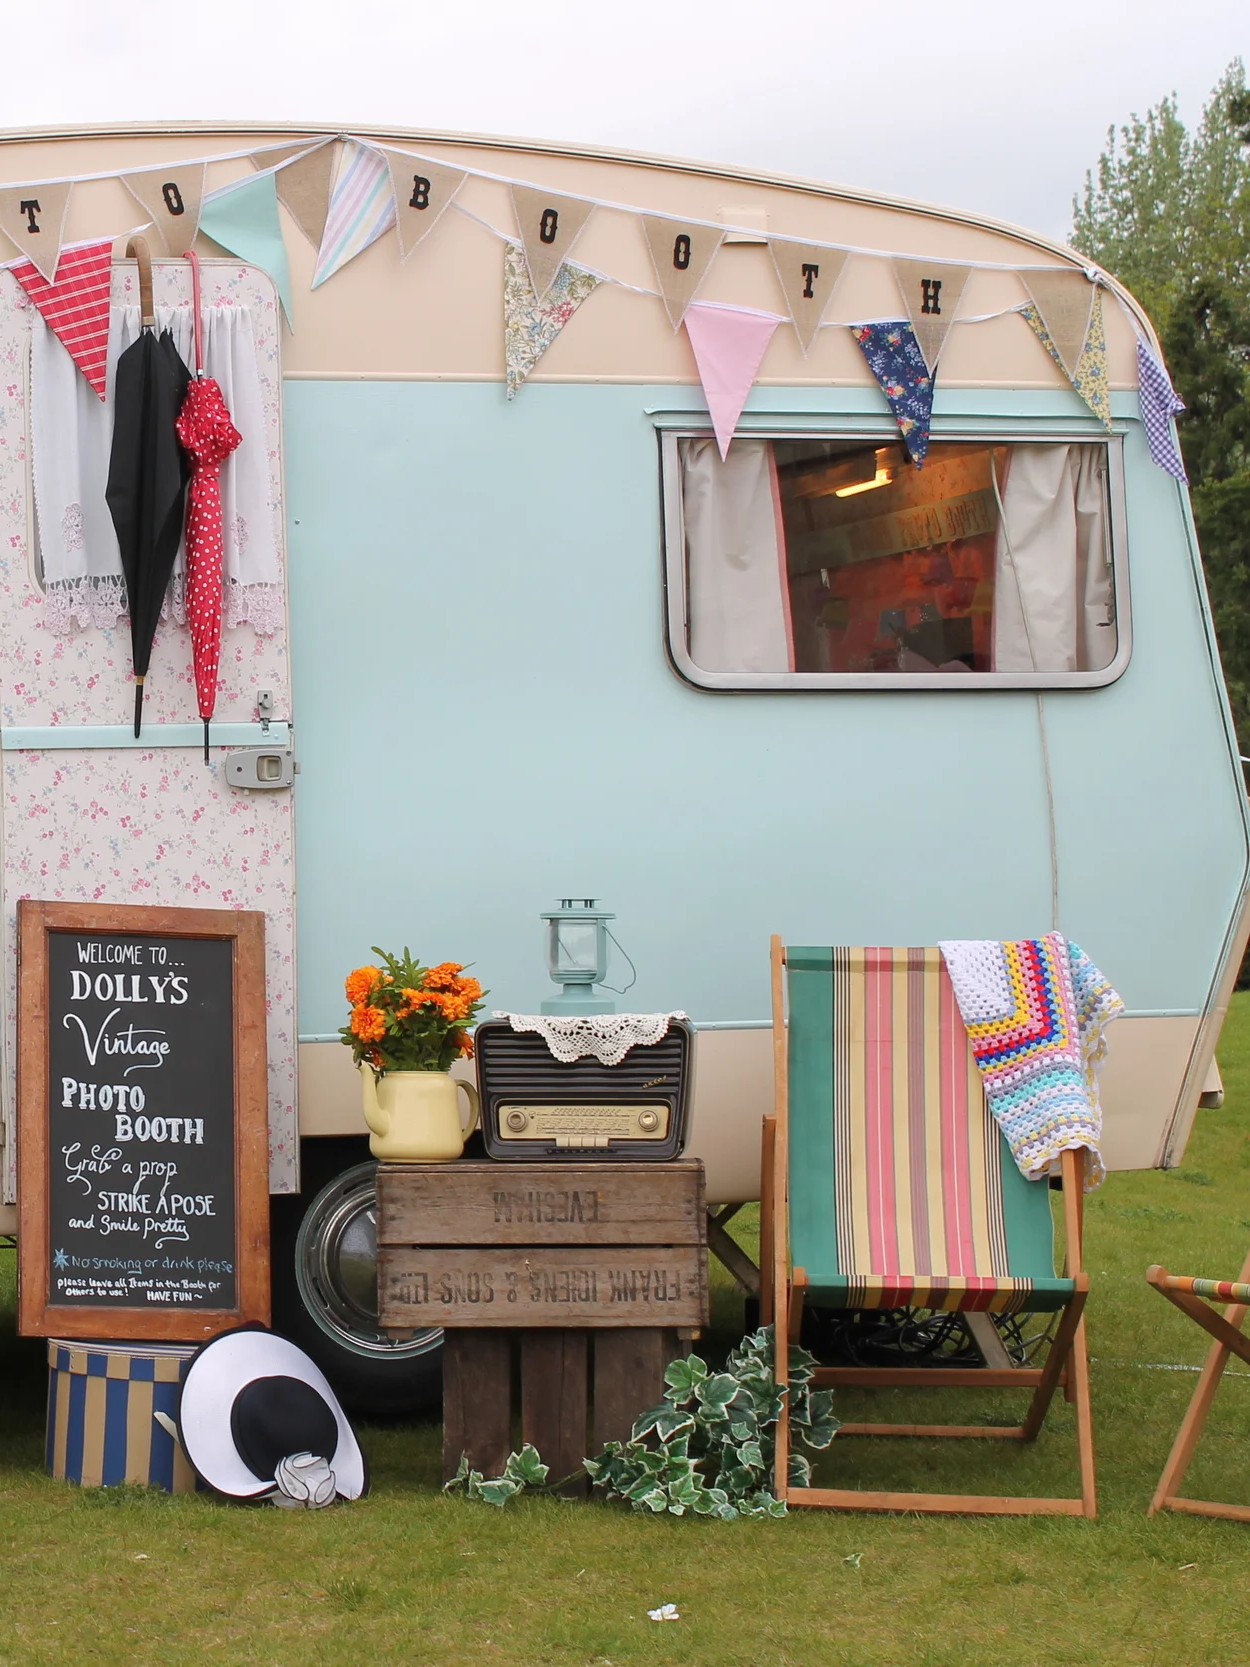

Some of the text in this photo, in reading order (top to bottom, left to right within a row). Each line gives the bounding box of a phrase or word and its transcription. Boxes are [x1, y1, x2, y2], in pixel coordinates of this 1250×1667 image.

[408, 174, 941, 315] BOOTH
[77, 941, 143, 965] WELCOME
[70, 970, 189, 1005] DOLLY'S
[62, 1007, 170, 1077] Vintage
[61, 1076, 145, 1112] PHOTO
[114, 1114, 205, 1145] BOOTH
[61, 1142, 178, 1196] Grab a prop
[97, 1191, 216, 1216] STRIKE A POSE
[68, 1214, 95, 1229] and
[100, 1214, 140, 1235] Smile
[72, 1256, 90, 1268] No
[144, 1259, 158, 1268] or
[162, 1256, 194, 1269] drink
[197, 1257, 233, 1273] please
[57, 1277, 86, 1290] please
[88, 1277, 113, 1287] leave
[114, 1278, 127, 1288] all
[155, 1278, 164, 1288] in
[165, 1279, 180, 1288] the
[181, 1279, 207, 1290] Booth
[208, 1281, 221, 1293] for
[65, 1287, 95, 1296] Others
[97, 1287, 107, 1296] to
[146, 1290, 193, 1302] HAVE FUN
[440, 1271, 494, 1305] SONS
[504, 1270, 518, 1303] &
[608, 1269, 681, 1303] FRANK
